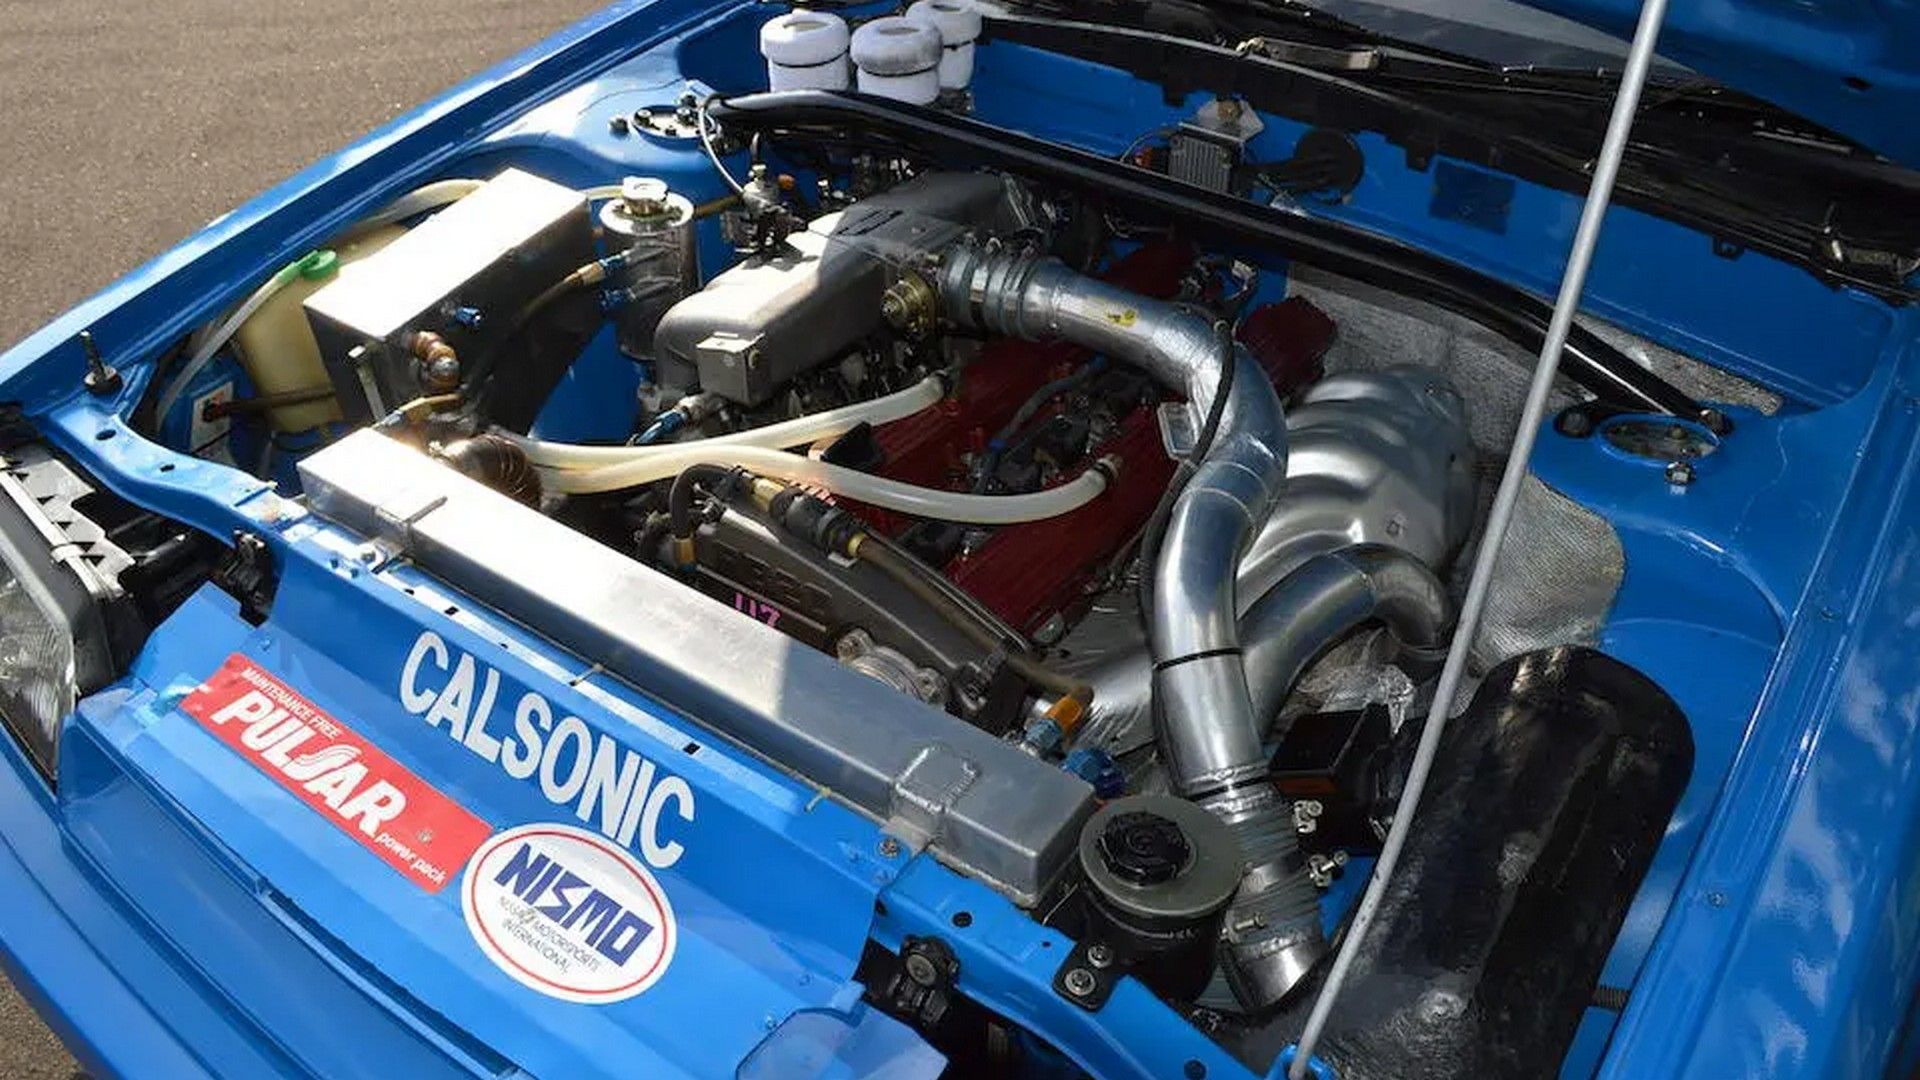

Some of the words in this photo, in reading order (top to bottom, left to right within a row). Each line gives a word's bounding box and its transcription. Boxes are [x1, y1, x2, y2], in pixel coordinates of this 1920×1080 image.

[240, 667, 314, 720] MAINTENANCE
[308, 714, 344, 741] FREE
[400, 630, 695, 869] CALSONIC
[211, 689, 407, 838] PULSAR
[374, 832, 417, 862] power
[410, 858, 448, 885] pack
[494, 842, 655, 967] NISMO
[502, 917, 572, 973] INTERNATIONAL
